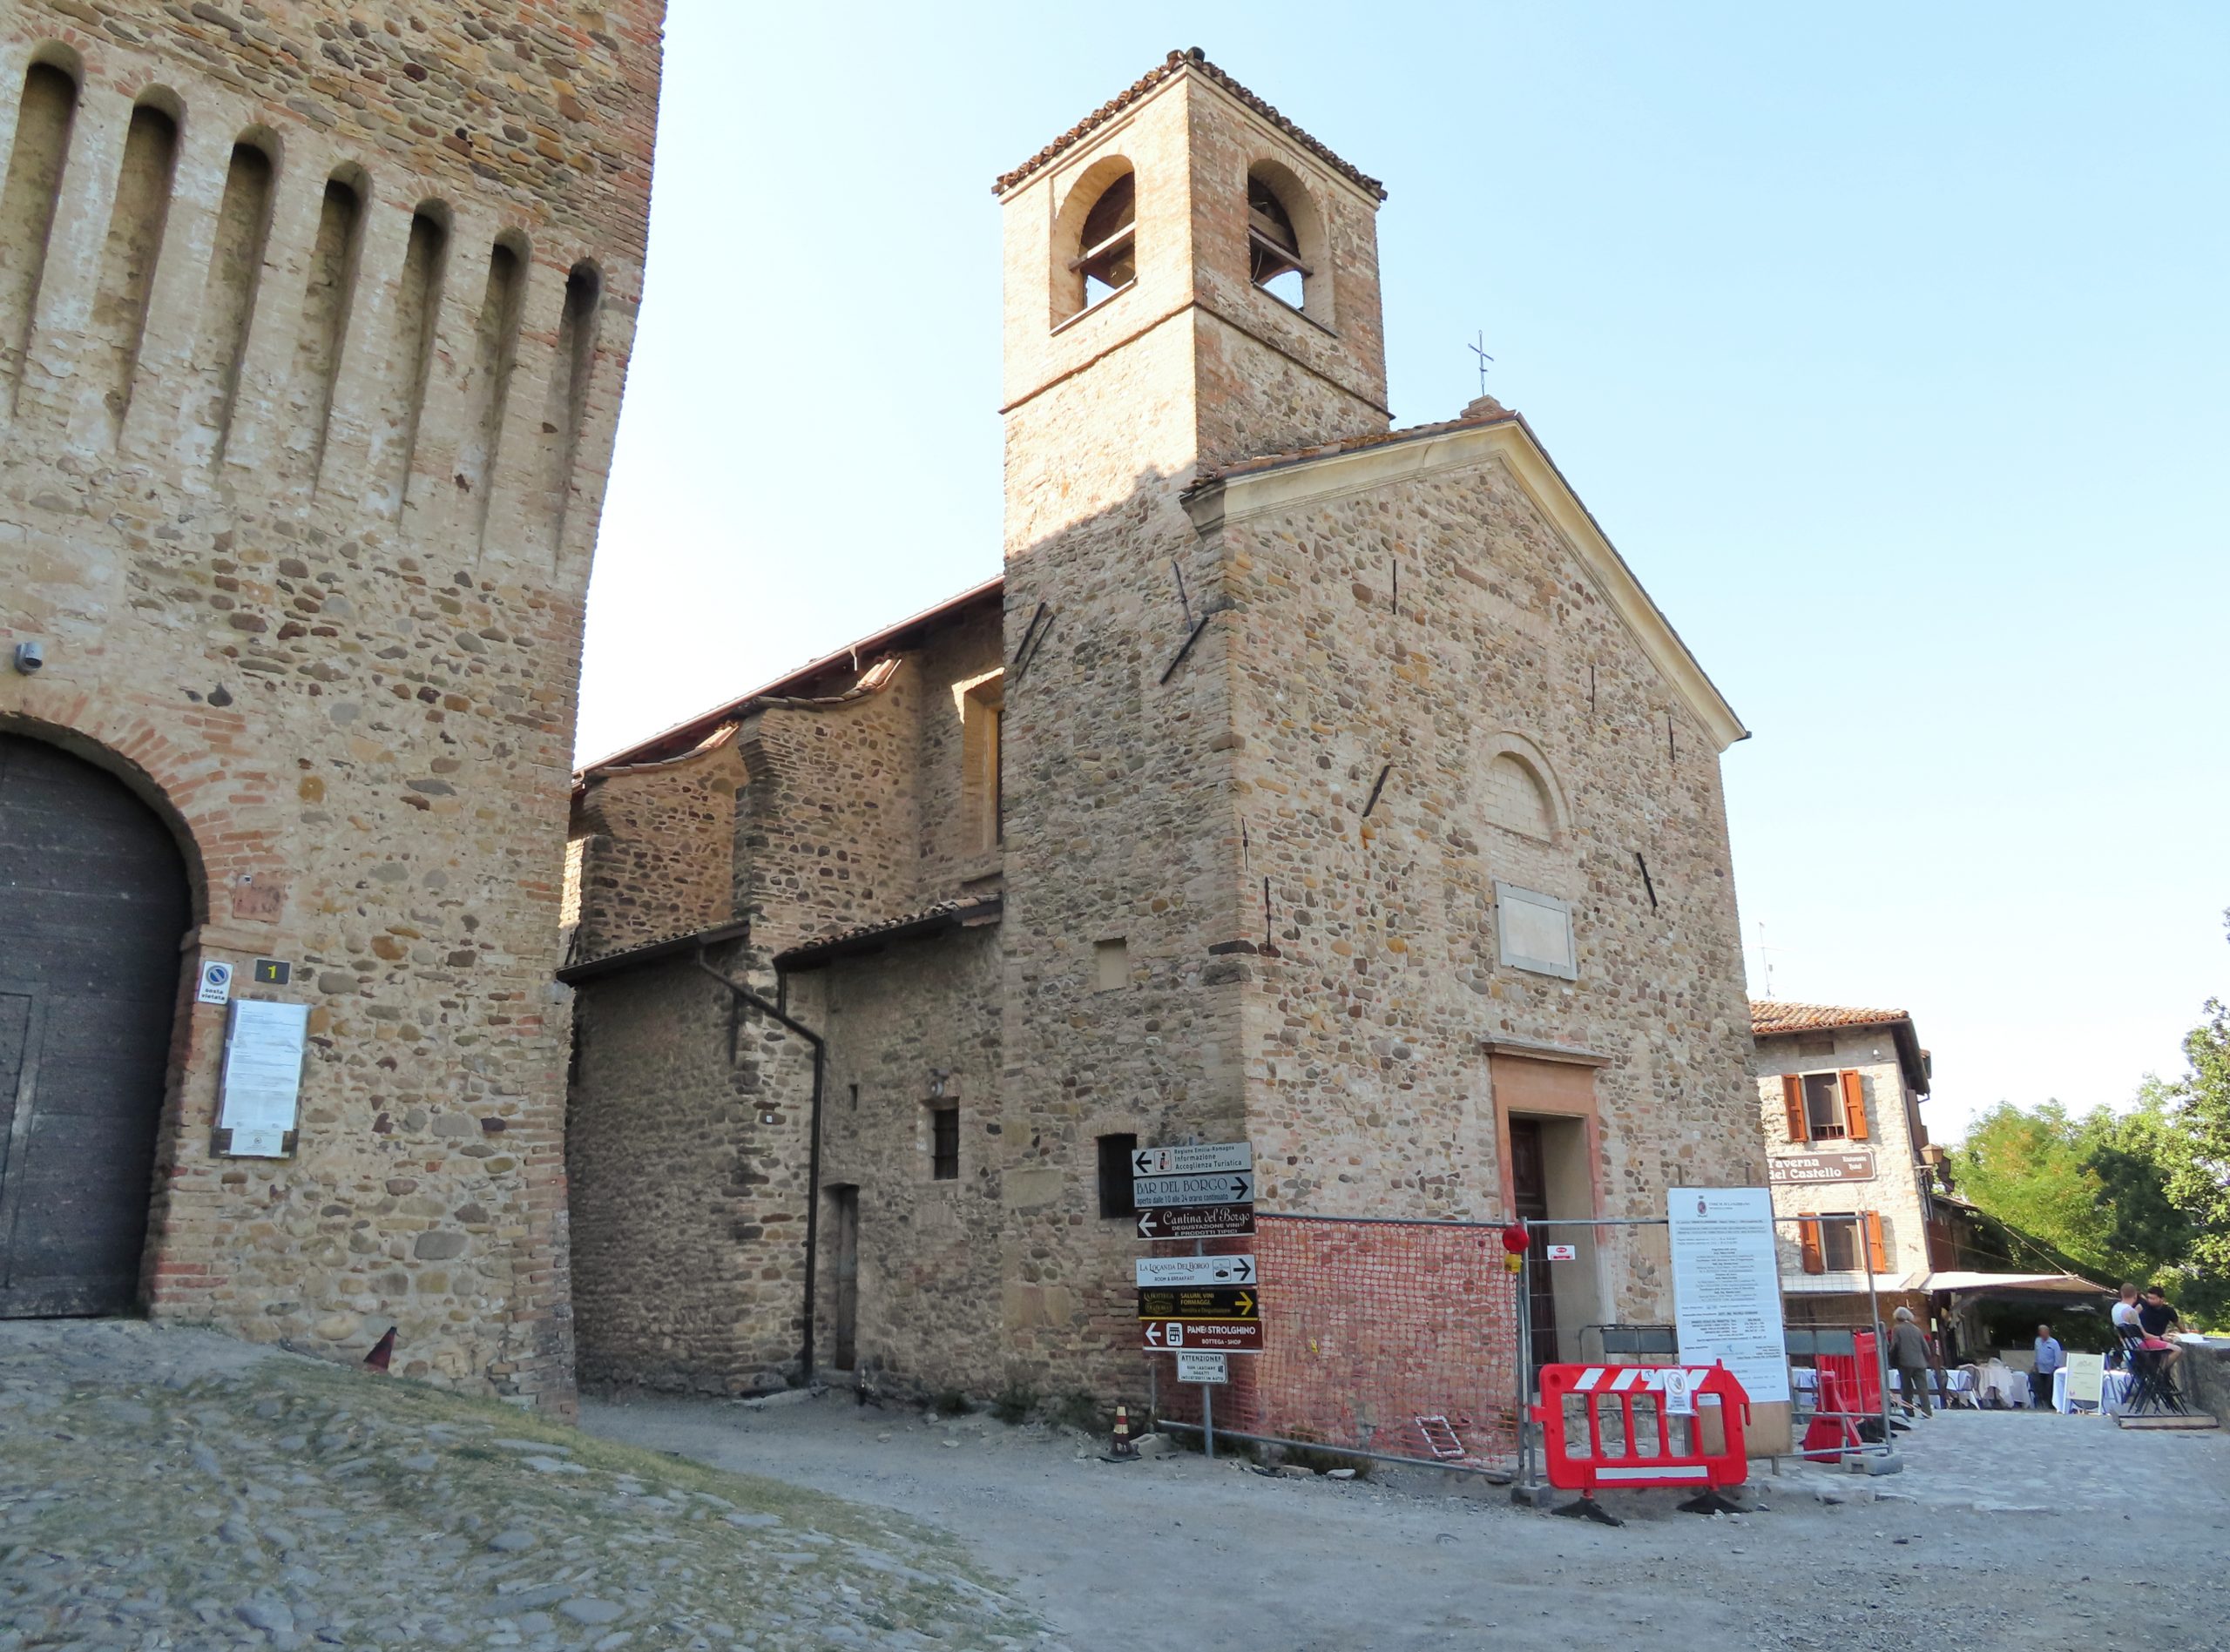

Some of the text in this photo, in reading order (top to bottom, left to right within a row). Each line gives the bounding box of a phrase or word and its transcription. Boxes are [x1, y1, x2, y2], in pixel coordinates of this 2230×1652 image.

[267, 965, 277, 980] 1
[1174, 1153, 1216, 1162] Informazione
[1175, 1159, 1242, 1170] Accoglienza Turistica
[1767, 1158, 1820, 1169] Taverna
[1789, 1167, 1842, 1179] Castello
[1137, 1177, 1228, 1195] BAR DEL BORGO
[1137, 1197, 1152, 1205] aperto
[1163, 1207, 1250, 1227] Cantina del Borgo
[1172, 1223, 1225, 1231] DEGUSTAZIONE
[1186, 1325, 1206, 1334] PANE
[1207, 1325, 1256, 1335] STROLGHINO
